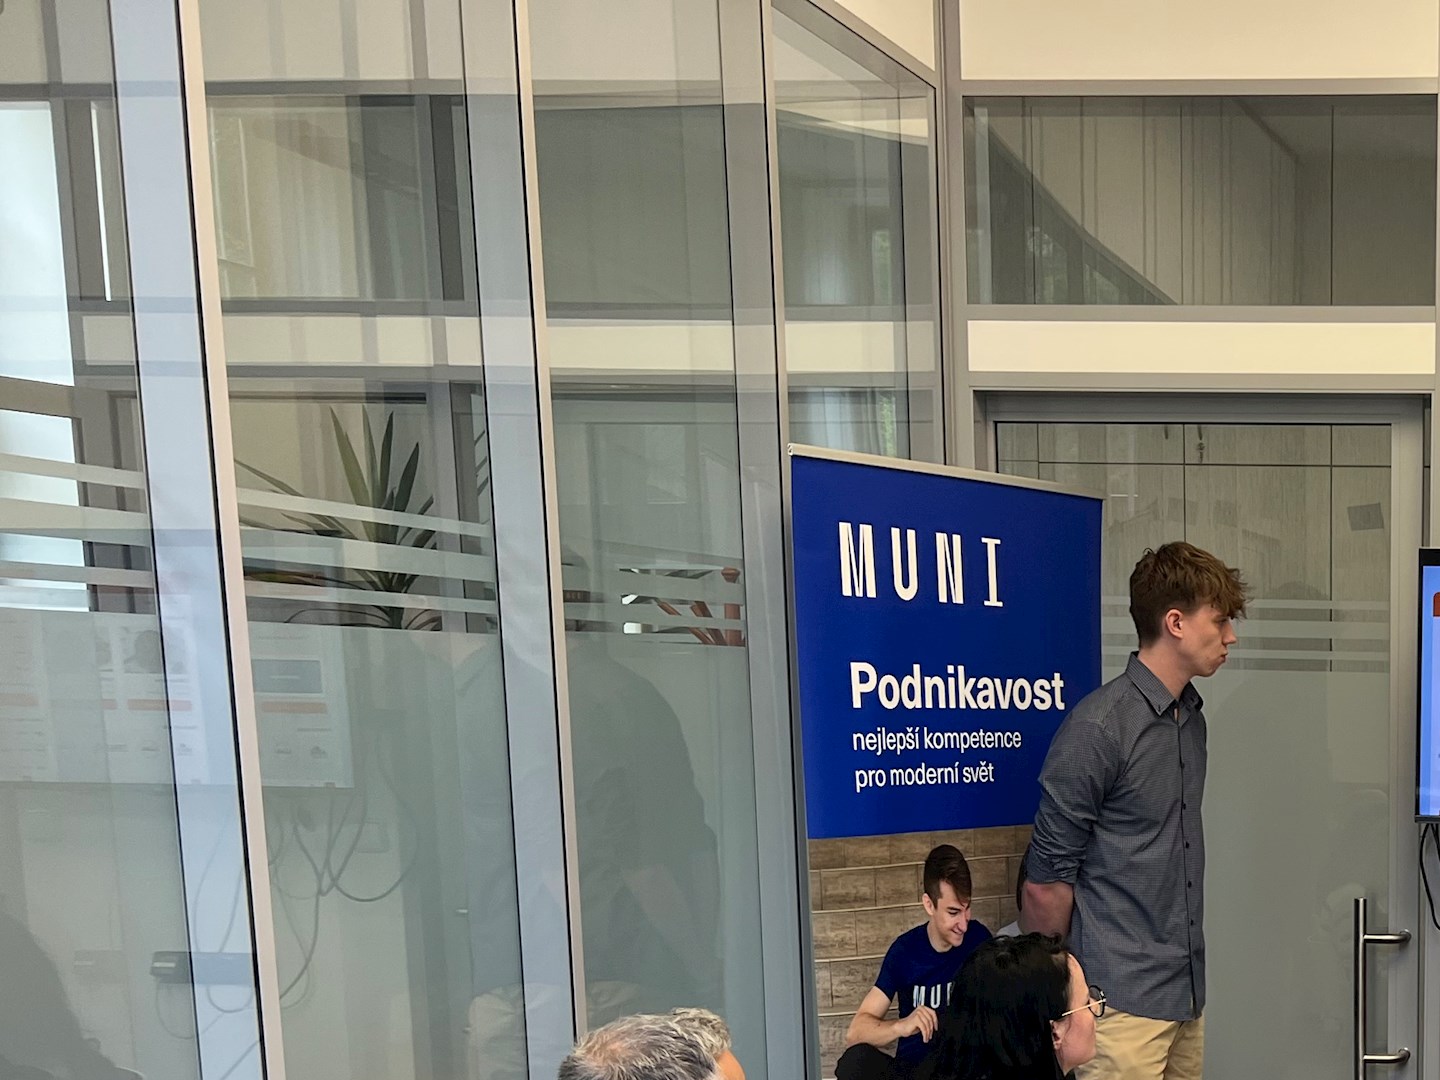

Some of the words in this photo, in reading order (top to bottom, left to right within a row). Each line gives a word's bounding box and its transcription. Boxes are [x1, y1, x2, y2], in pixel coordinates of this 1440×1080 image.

[838, 521, 1003, 607] MUNI
[850, 661, 1066, 710] Podnikavost
[853, 727, 920, 756] nejlepší
[923, 727, 1022, 753] kompetence
[855, 768, 887, 793] pro
[890, 762, 959, 785] moderní
[962, 761, 995, 783] svět
